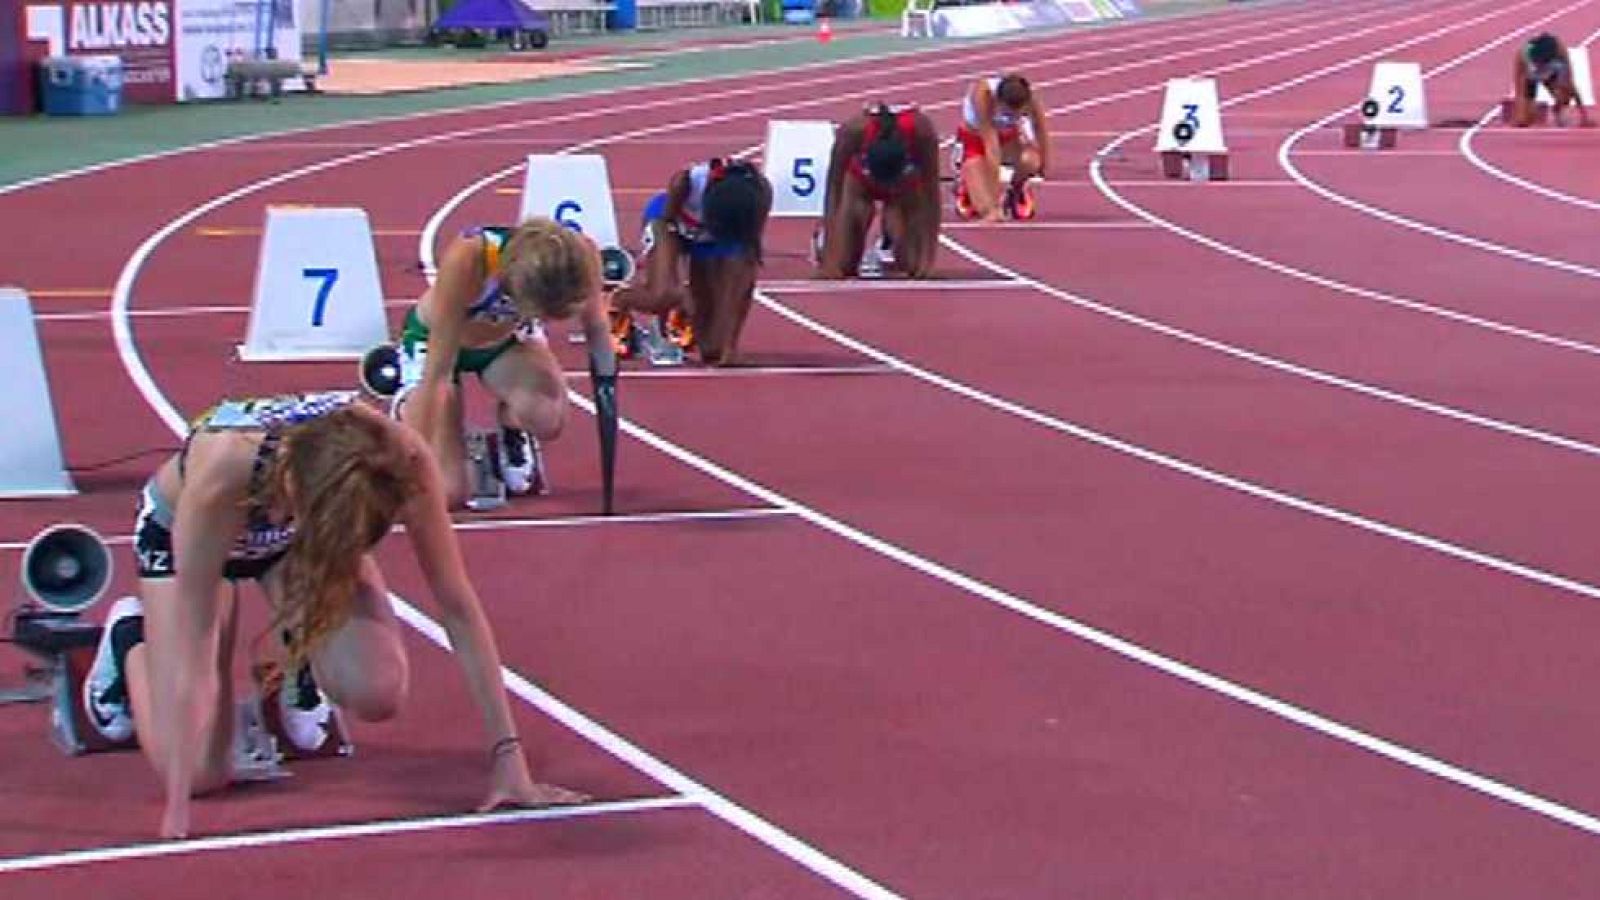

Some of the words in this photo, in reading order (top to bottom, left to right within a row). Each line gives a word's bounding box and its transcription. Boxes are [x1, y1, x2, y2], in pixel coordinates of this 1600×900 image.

[70, 2, 169, 49] ALKASS
[1182, 104, 1201, 130] 3
[1386, 85, 1406, 114] 2
[792, 158, 816, 196] 5
[554, 199, 583, 233] 6
[302, 268, 339, 327] 7
